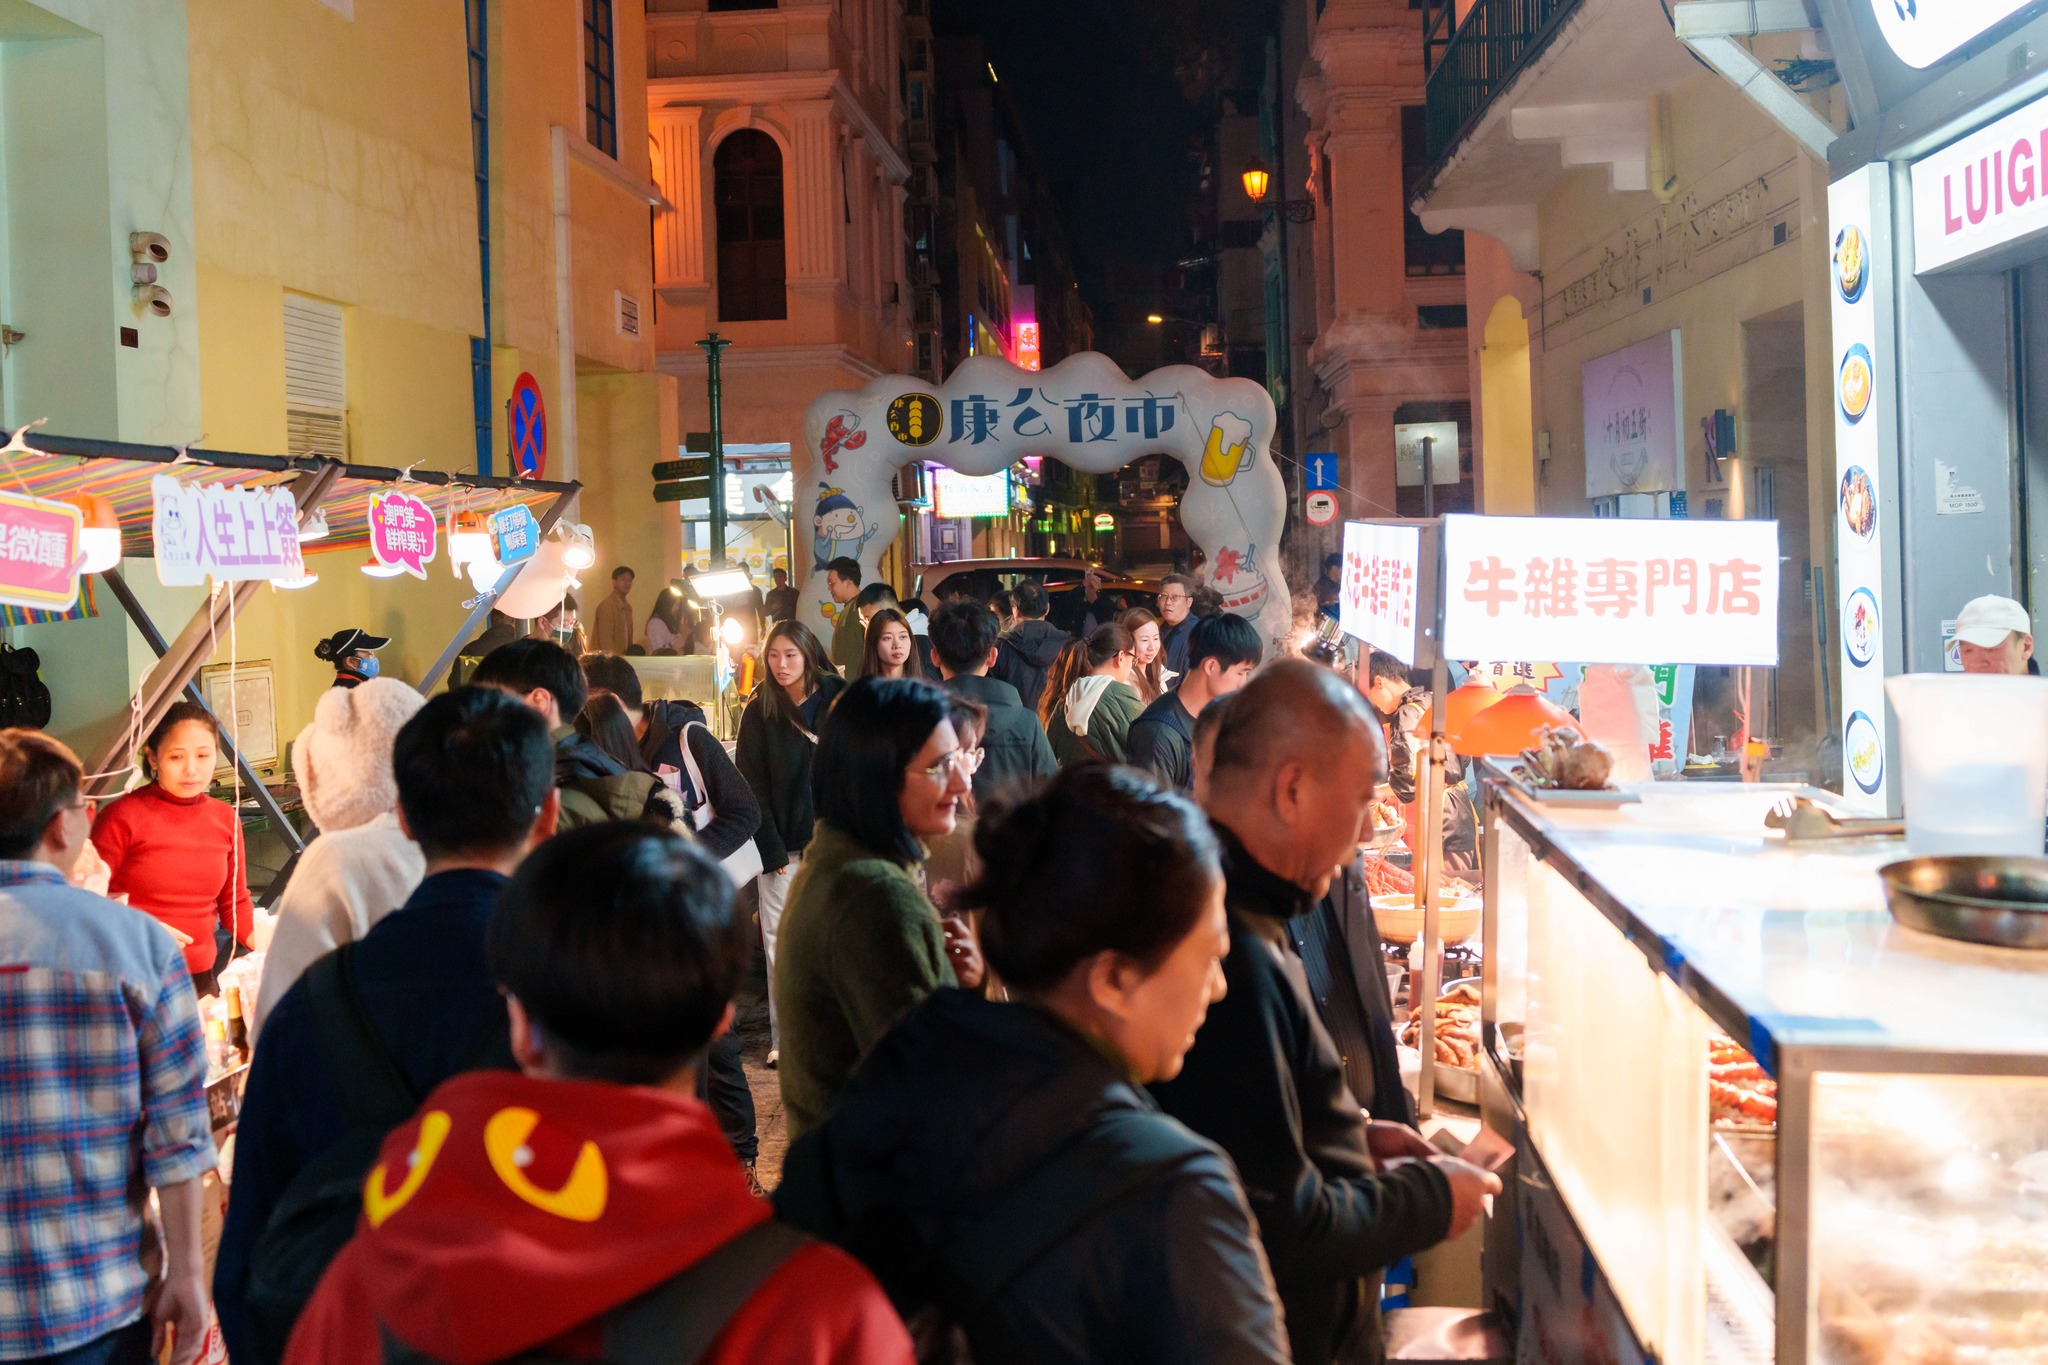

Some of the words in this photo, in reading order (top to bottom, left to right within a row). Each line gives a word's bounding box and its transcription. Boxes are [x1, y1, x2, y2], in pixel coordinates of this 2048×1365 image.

[948, 387, 1178, 445] 康公夜市
[383, 503, 425, 529] 澳門第一
[385, 527, 428, 555] 鮮榨果汁
[1463, 556, 1762, 619] 牛雜專門店
